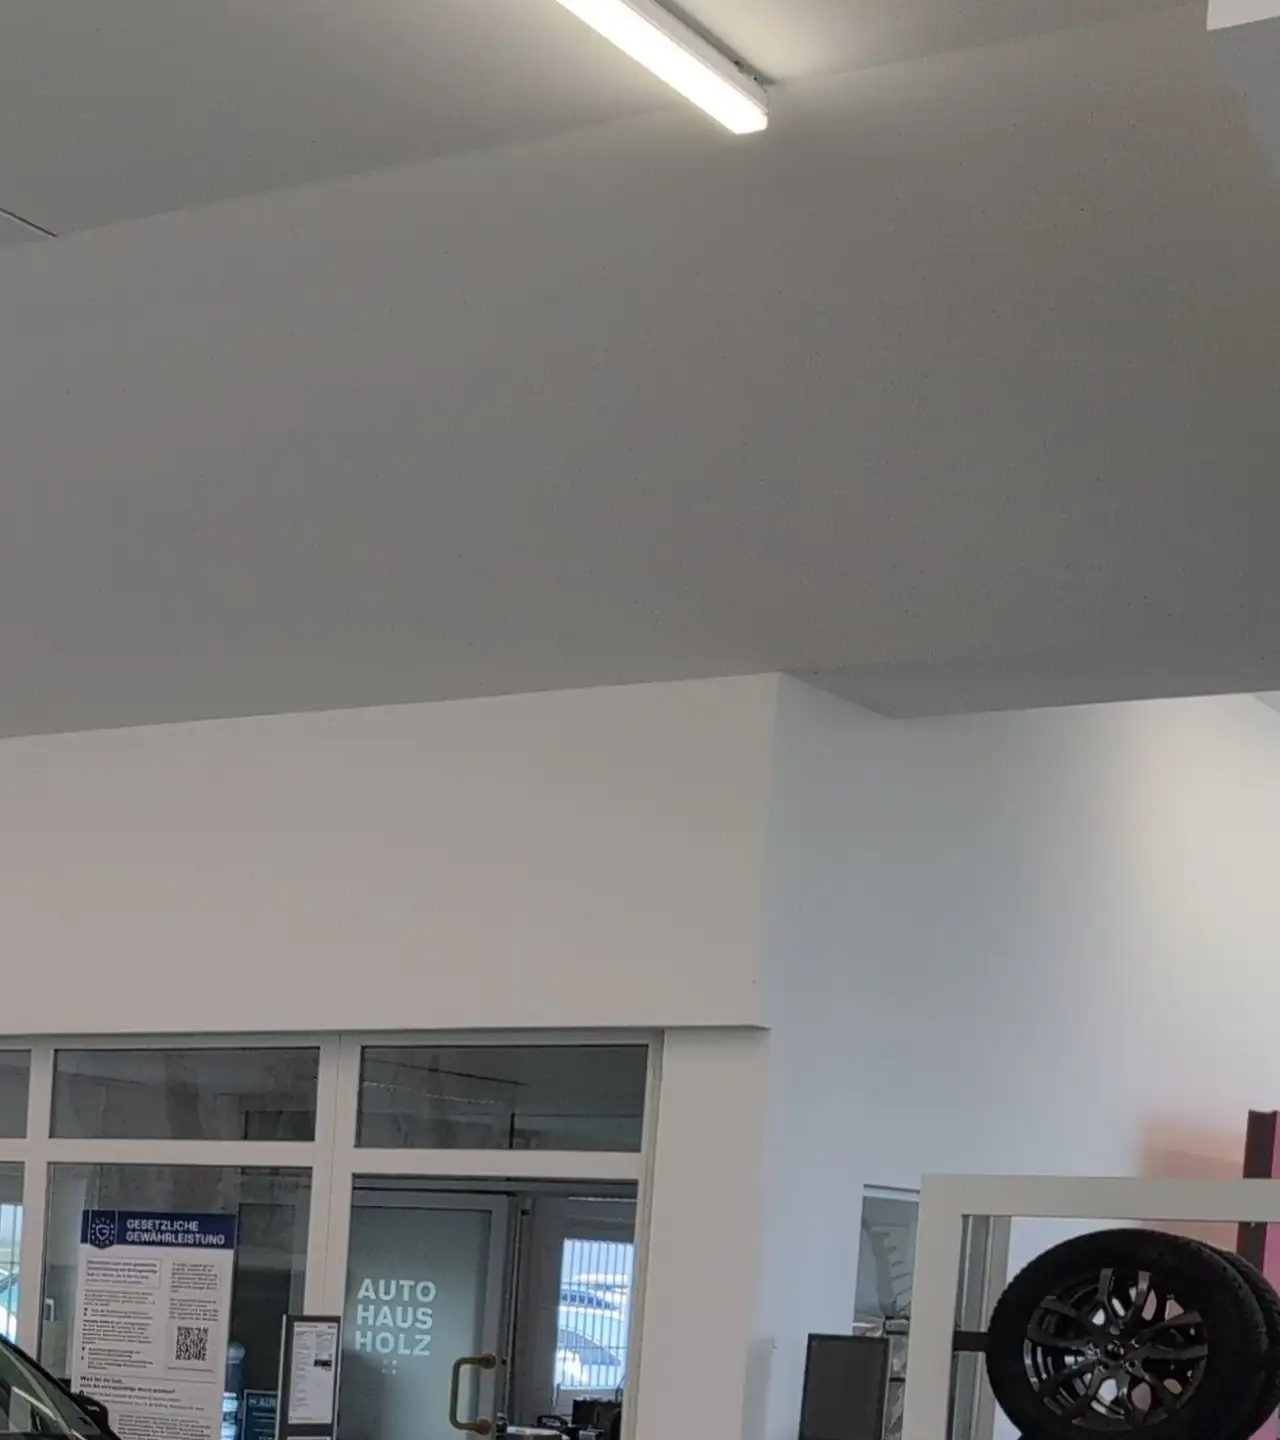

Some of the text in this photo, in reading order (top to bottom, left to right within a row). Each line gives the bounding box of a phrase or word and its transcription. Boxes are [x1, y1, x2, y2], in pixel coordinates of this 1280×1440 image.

[126, 1219, 200, 1231] GESETZLICHE
[125, 1230, 226, 1246] GEWÄHRLEISTUNG
[356, 1278, 437, 1303] AUTO
[356, 1304, 433, 1330] HAUS
[354, 1330, 432, 1357] HOLZ
